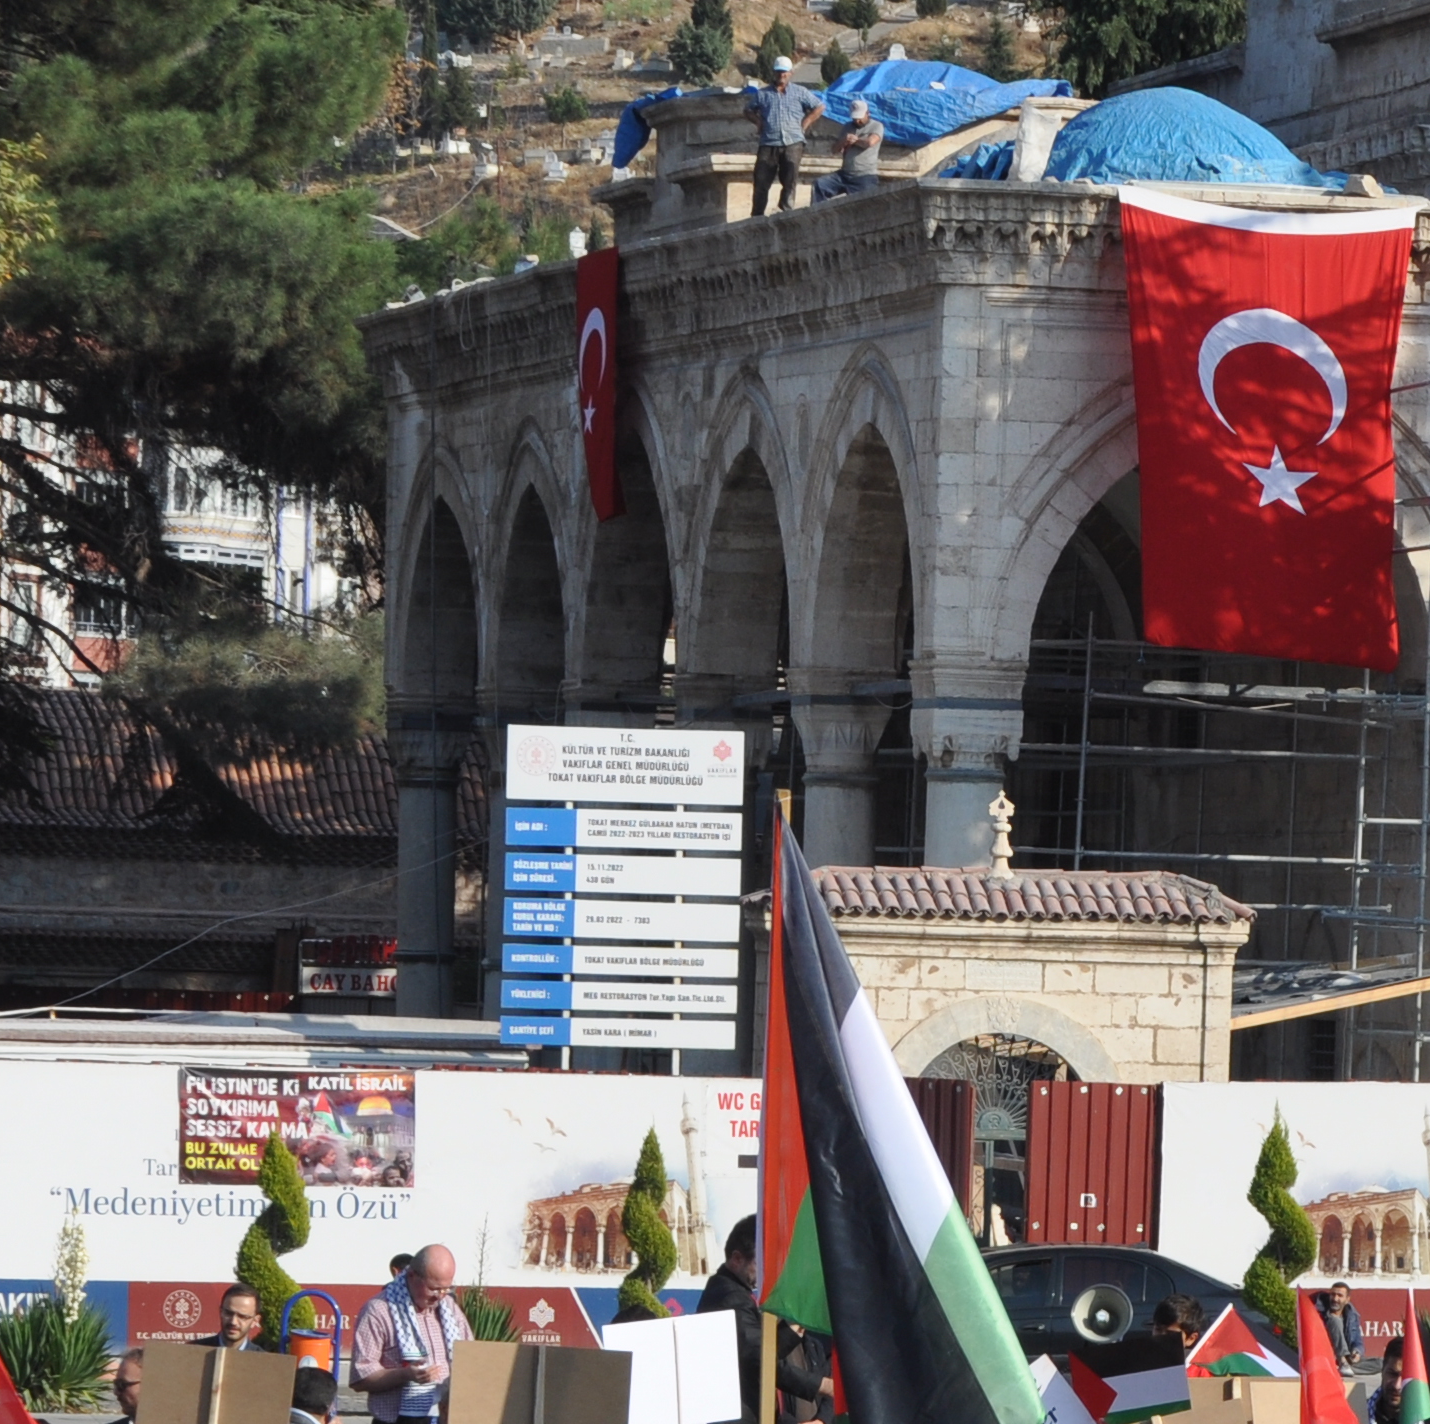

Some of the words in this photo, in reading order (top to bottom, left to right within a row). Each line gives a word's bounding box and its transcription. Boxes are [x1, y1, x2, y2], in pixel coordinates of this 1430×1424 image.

[620, 733, 636, 743] T.C.
[562, 744, 594, 756] KÜLTÜR
[597, 746, 607, 756] VE
[610, 746, 642, 757] TURİZM
[645, 747, 690, 758] BAKANLIĞI
[562, 759, 603, 769] VAKIFLAR
[605, 760, 633, 770] GENEL
[635, 761, 690, 772] MÜDÜRLÜĞÜ
[548, 773, 574, 783] TOKAT
[576, 774, 617, 783] VAKIFLAR
[620, 774, 646, 785] BÖLGE
[649, 775, 703, 786] MÜDÜRLÜĞÜ
[310, 972, 346, 993] ÇAY
[308, 1073, 354, 1091] KATİL
[355, 1073, 407, 1092] İSRAİL
[186, 1097, 279, 1117] SOYKIRIMA
[717, 1092, 744, 1111] WC
[185, 1119, 242, 1138] SESSİZ
[185, 1141, 206, 1155] BU
[209, 1142, 258, 1156] ZULME
[185, 1156, 236, 1170] ORTAK
[522, 1333, 561, 1344] VAKIFLAR
